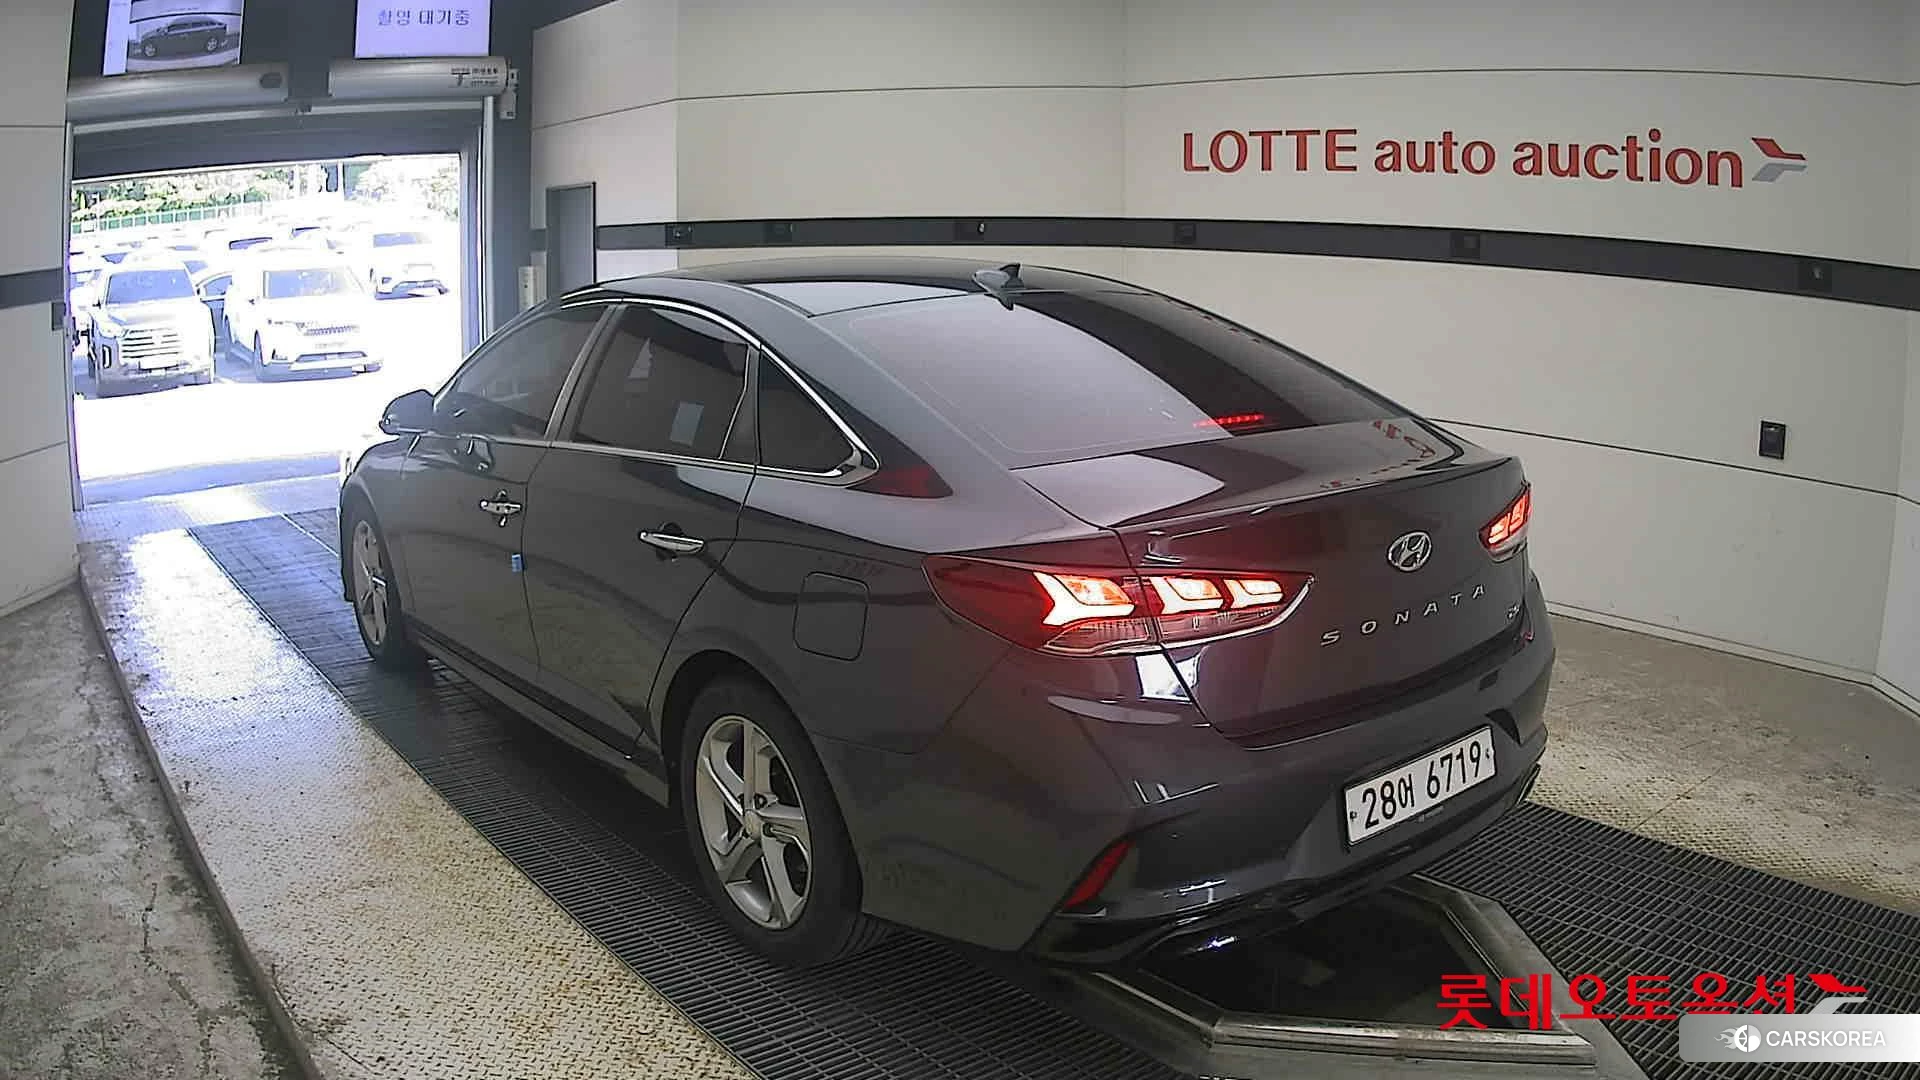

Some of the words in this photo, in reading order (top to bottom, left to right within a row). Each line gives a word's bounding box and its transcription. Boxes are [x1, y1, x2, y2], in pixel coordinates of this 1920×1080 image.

[418, 9, 471, 26] 대기중
[1183, 129, 1358, 173] LOTTE
[1374, 130, 1496, 174] auto
[1513, 128, 1743, 188] auction
[1320, 584, 1486, 647] SONATA
[1361, 773, 1415, 829] 28어
[1426, 741, 1481, 799] 6719
